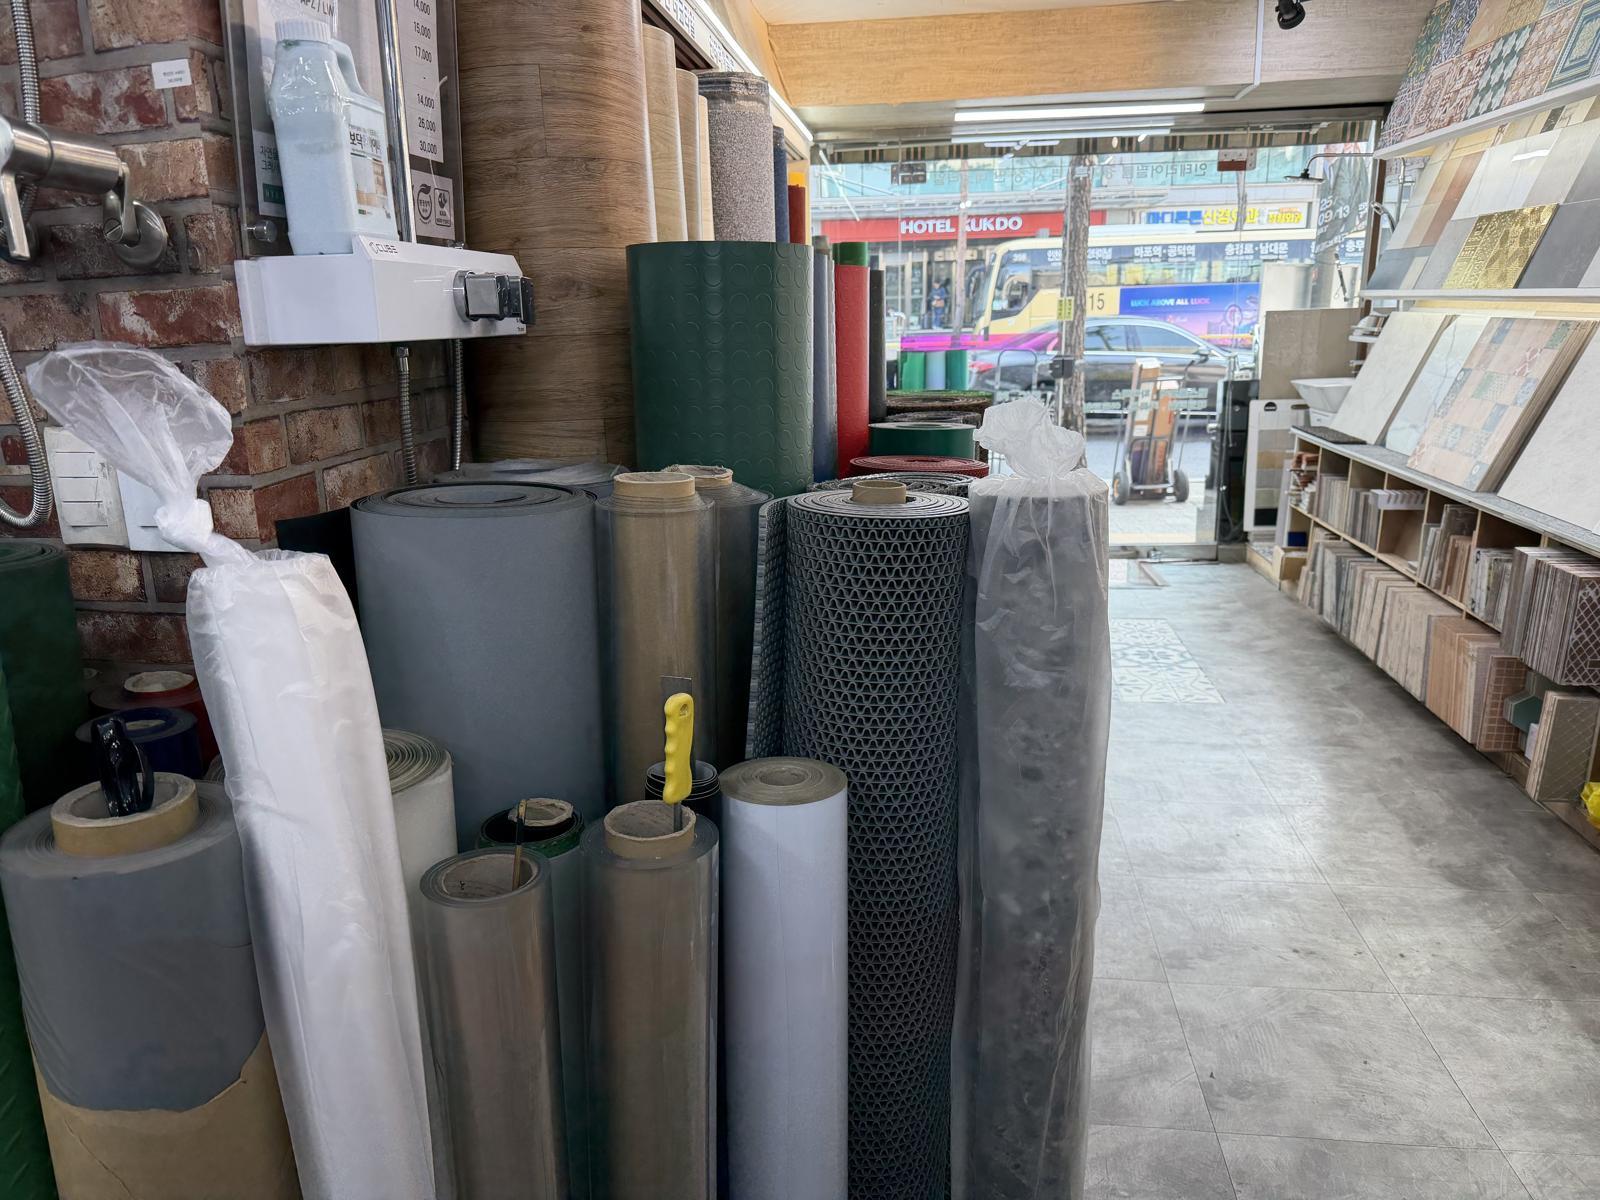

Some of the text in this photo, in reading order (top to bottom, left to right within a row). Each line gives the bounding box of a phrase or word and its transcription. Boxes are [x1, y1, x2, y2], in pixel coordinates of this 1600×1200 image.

[413, 21, 432, 40] 15,000
[414, 45, 433, 63] 17,000
[417, 93, 435, 110] 14,000
[419, 140, 438, 155] 30,000
[900, 218, 955, 235] HOTEL
[1150, 298, 1174, 307] ABOVE
[1175, 298, 1189, 306] ALL
